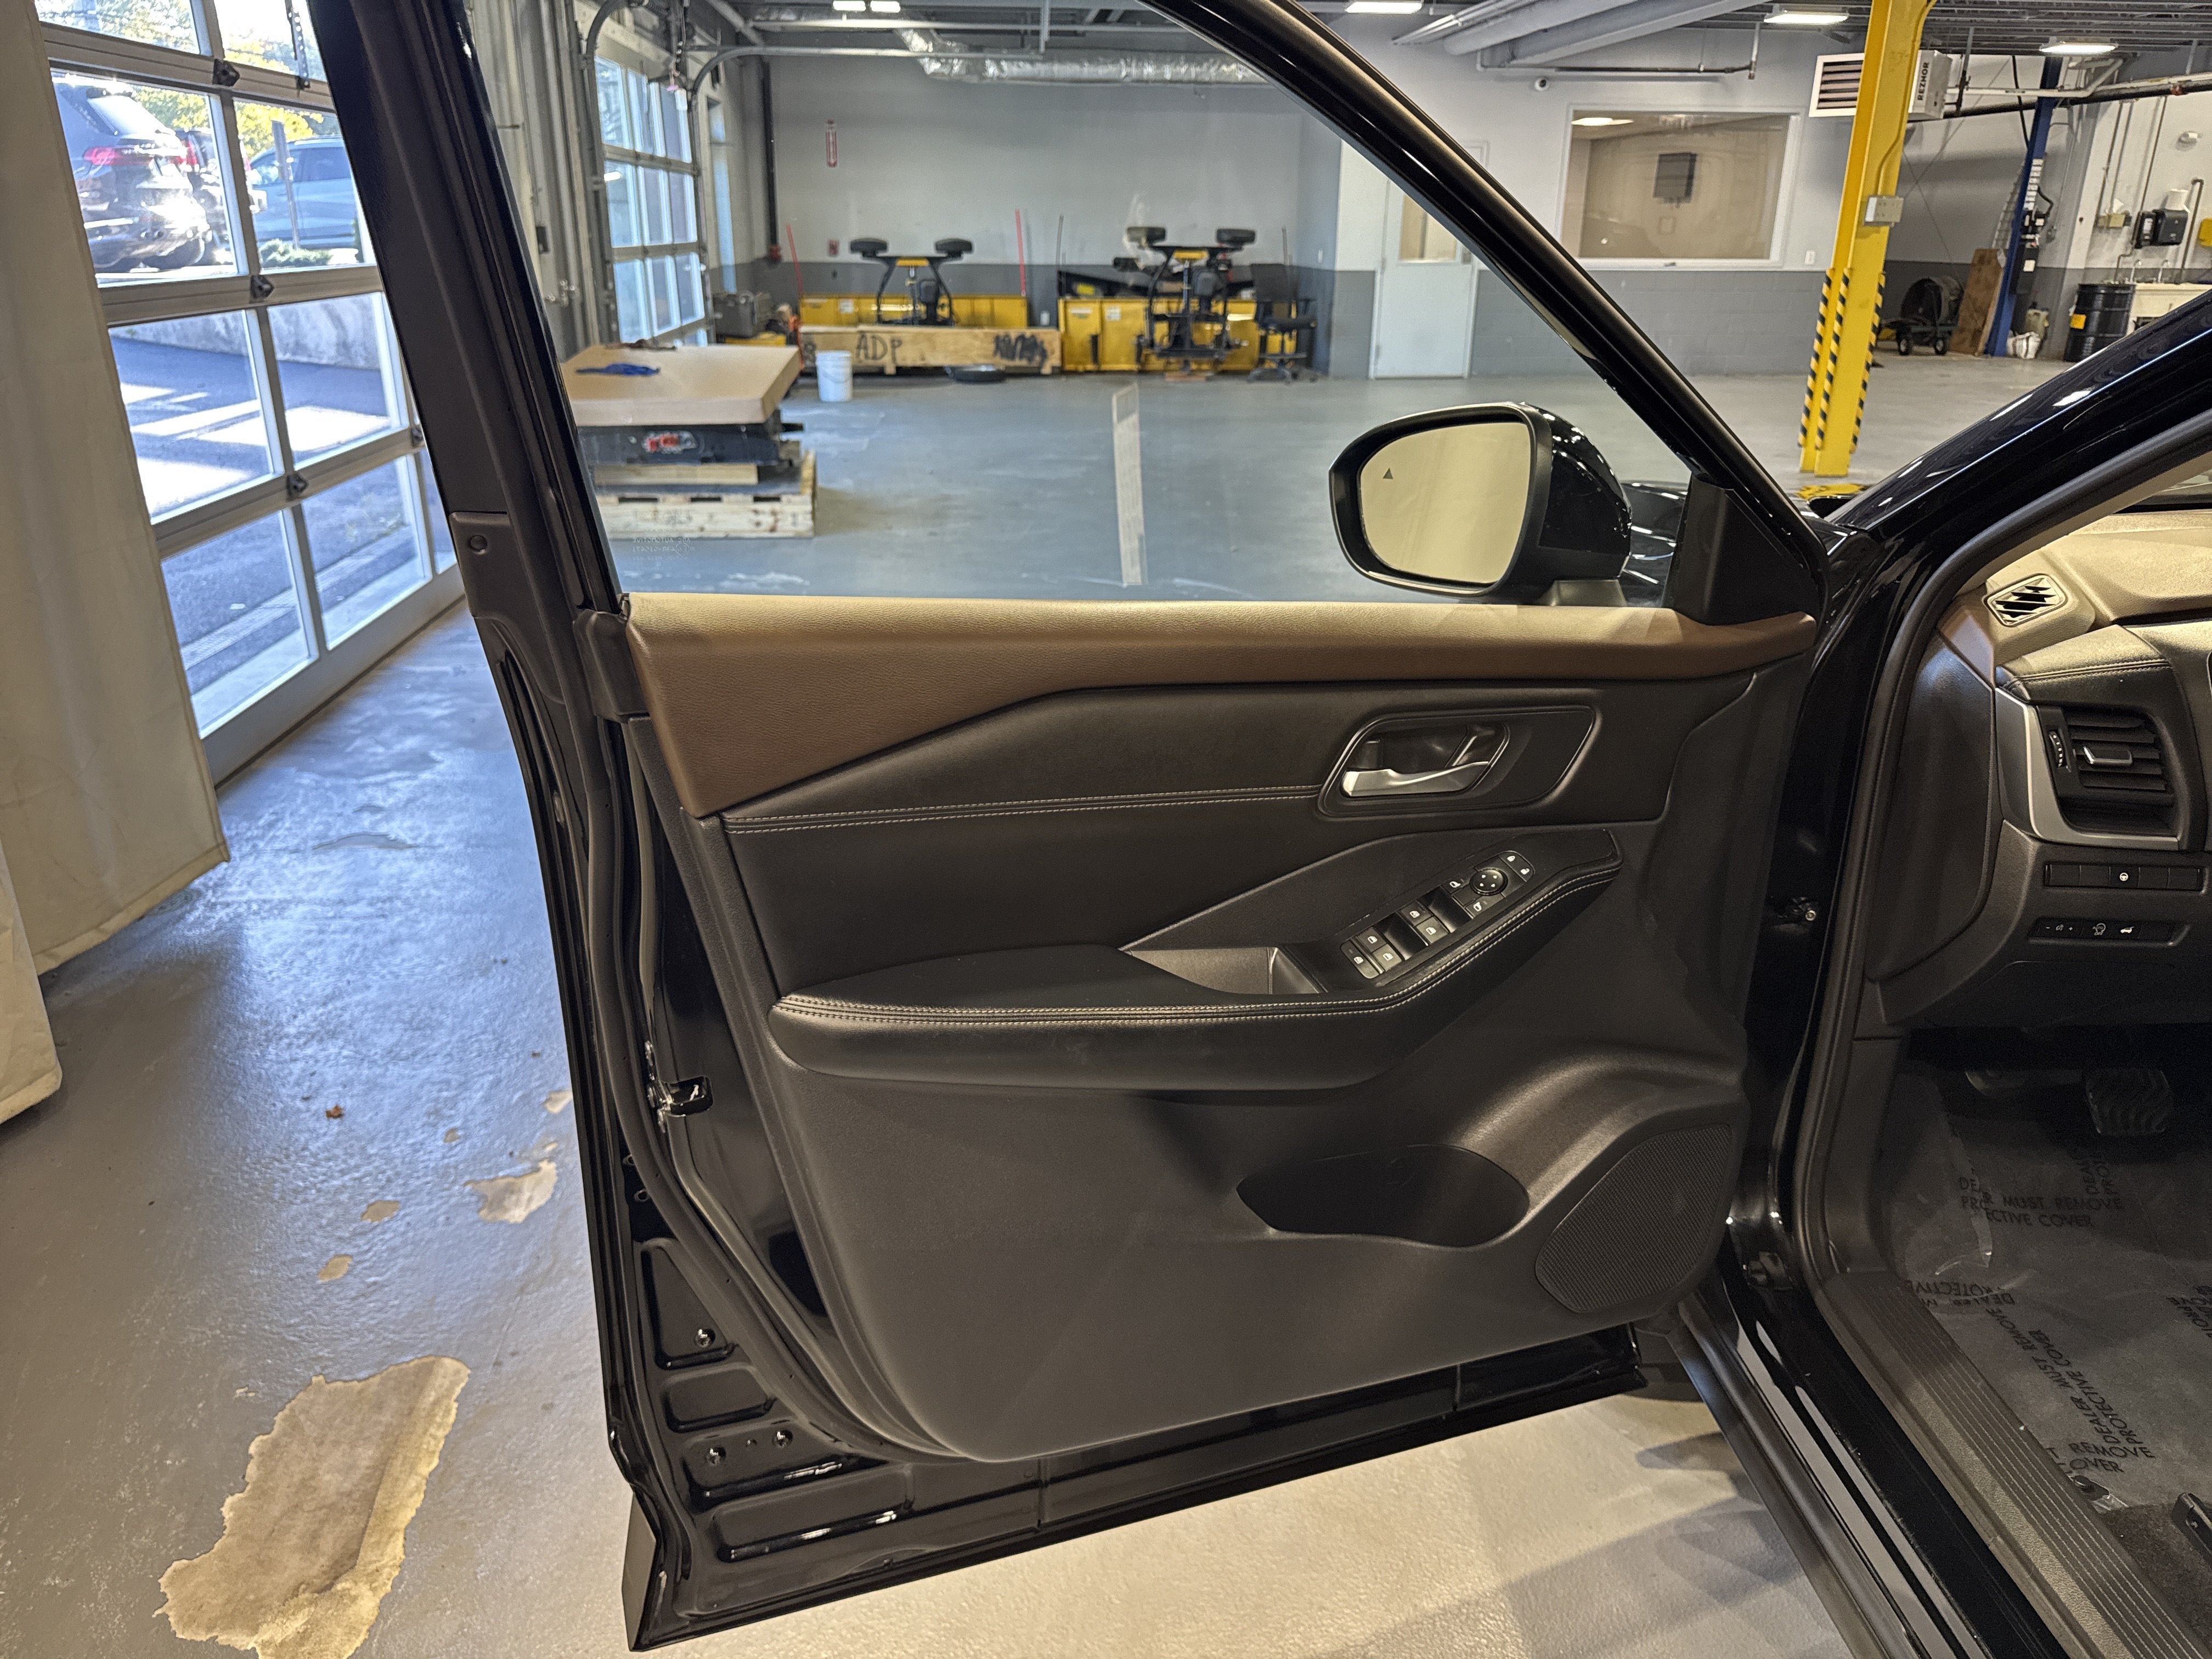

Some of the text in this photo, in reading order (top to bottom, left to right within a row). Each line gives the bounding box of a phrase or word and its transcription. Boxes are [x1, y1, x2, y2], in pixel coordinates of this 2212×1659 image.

[1917, 62, 1929, 100] REZNOR
[856, 332, 902, 364] ADP
[2002, 1195, 2044, 1210] MUST
[2054, 1196, 2125, 1211] REMOVE
[2038, 1213, 2095, 1228] COVER
[1985, 1307, 2121, 1445] DEALER MUST REMOVE
[2028, 1328, 2144, 1445] PROTECTIVE COVER
[2068, 1441, 2155, 1459] REMOVE
